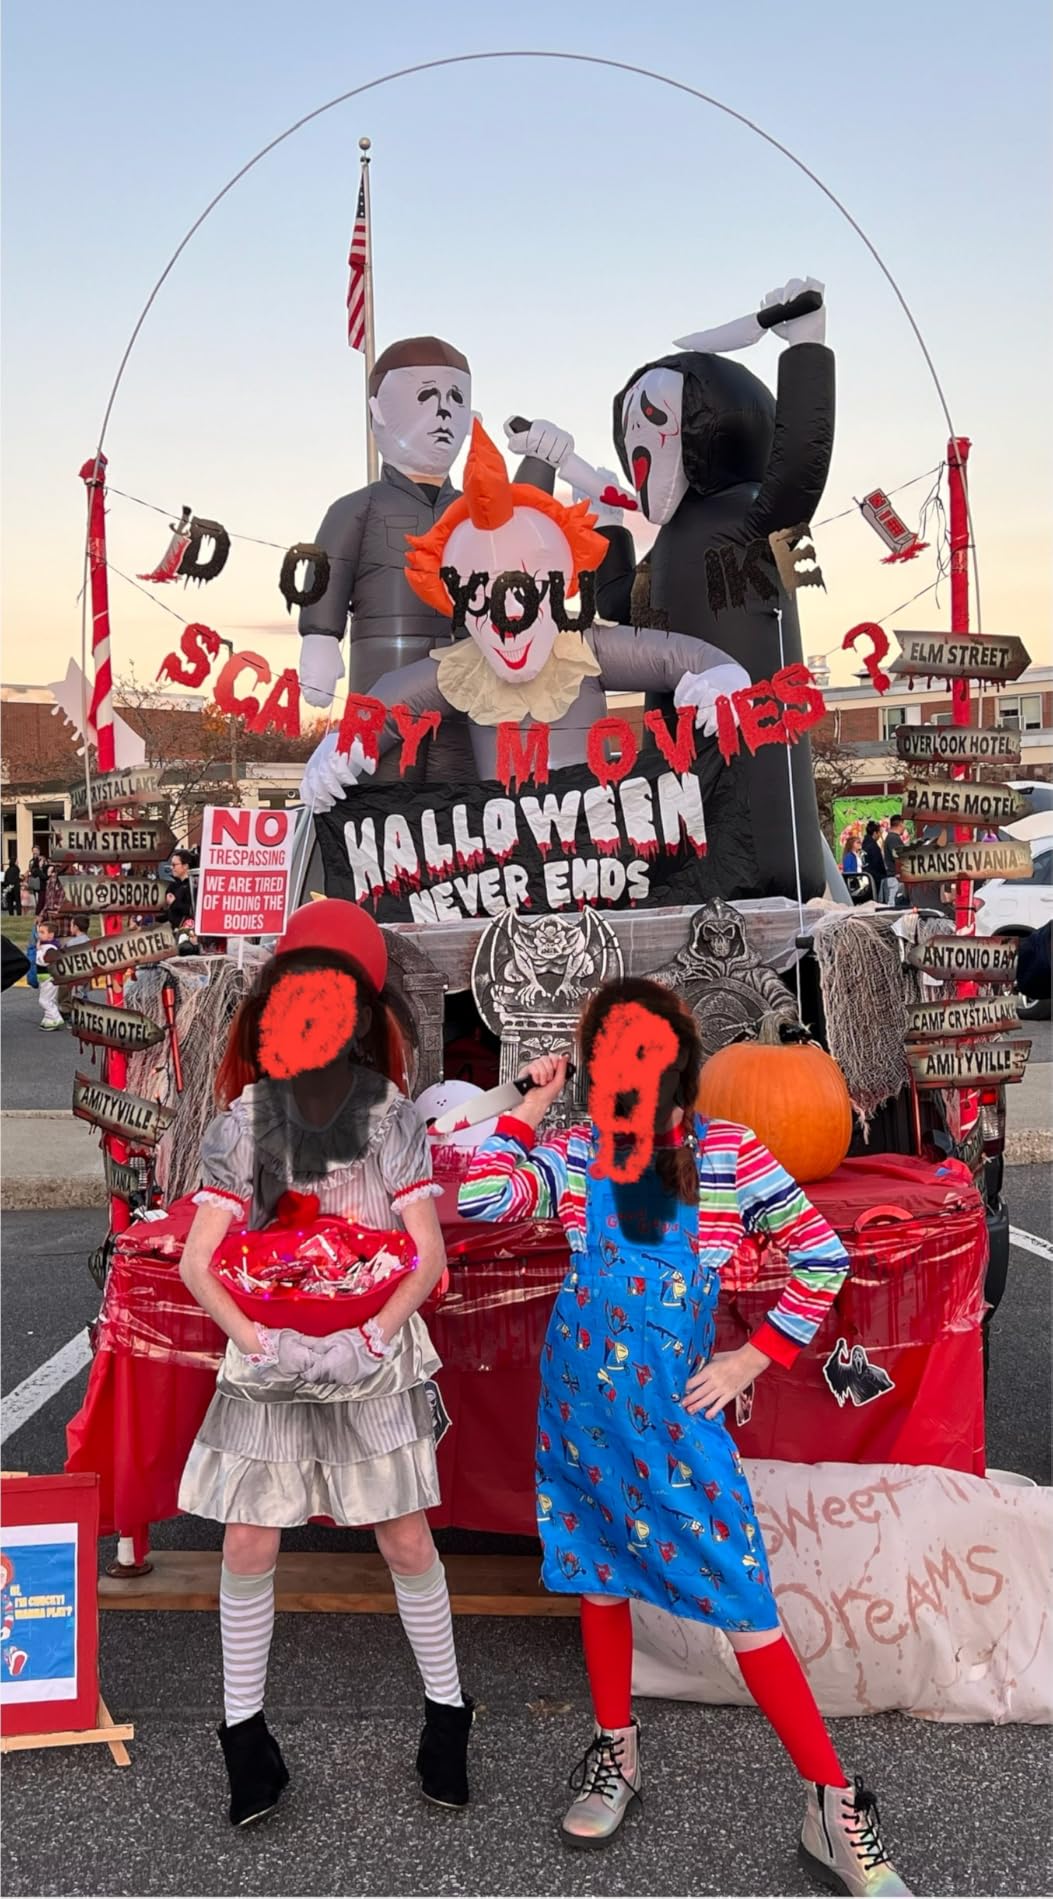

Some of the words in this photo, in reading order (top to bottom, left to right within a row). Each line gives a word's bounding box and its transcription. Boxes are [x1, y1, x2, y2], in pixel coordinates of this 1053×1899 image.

[439, 566, 597, 640] YOU
[630, 522, 827, 637] LIKE
[910, 642, 944, 663] ELM
[947, 645, 1009, 668] STREET
[156, 623, 442, 779] SCARY
[903, 735, 967, 754] OVERLOOK
[970, 736, 1012, 755] HOTEL
[90, 779, 126, 802] RYSTAL
[129, 775, 157, 796] LAKE
[907, 790, 960, 812] BATES
[964, 794, 1017, 817] MOTEL
[68, 831, 97, 850] ELM
[101, 831, 157, 852] STREET
[211, 809, 288, 847] NO
[344, 771, 708, 912] HALLOWEEN
[209, 848, 285, 866] TRESPASSING
[908, 850, 1018, 875] TRANSYLVANIA
[206, 876, 225, 892] WE
[228, 877, 252, 893] ARE
[255, 877, 284, 892] TIRED
[408, 863, 535, 923] NEVER
[543, 857, 651, 912] ENDS
[204, 894, 219, 910] OF
[222, 895, 260, 911] HIDING
[263, 895, 283, 911] THE
[224, 914, 264, 930] BODIES
[56, 944, 126, 976] OVERLOOK
[127, 932, 169, 958] HOTEL
[923, 946, 990, 969] ANTONIO
[993, 949, 1017, 970] BAY
[73, 1008, 104, 1034] BATES
[106, 1019, 149, 1044] MOTEL
[913, 1011, 945, 1032] CAMP
[948, 1004, 992, 1030] CRYSTAL
[995, 1001, 1016, 1023] LAKE
[926, 1050, 1010, 1076] AMITYVILLE
[81, 1086, 153, 1130] AMITYVILLE
